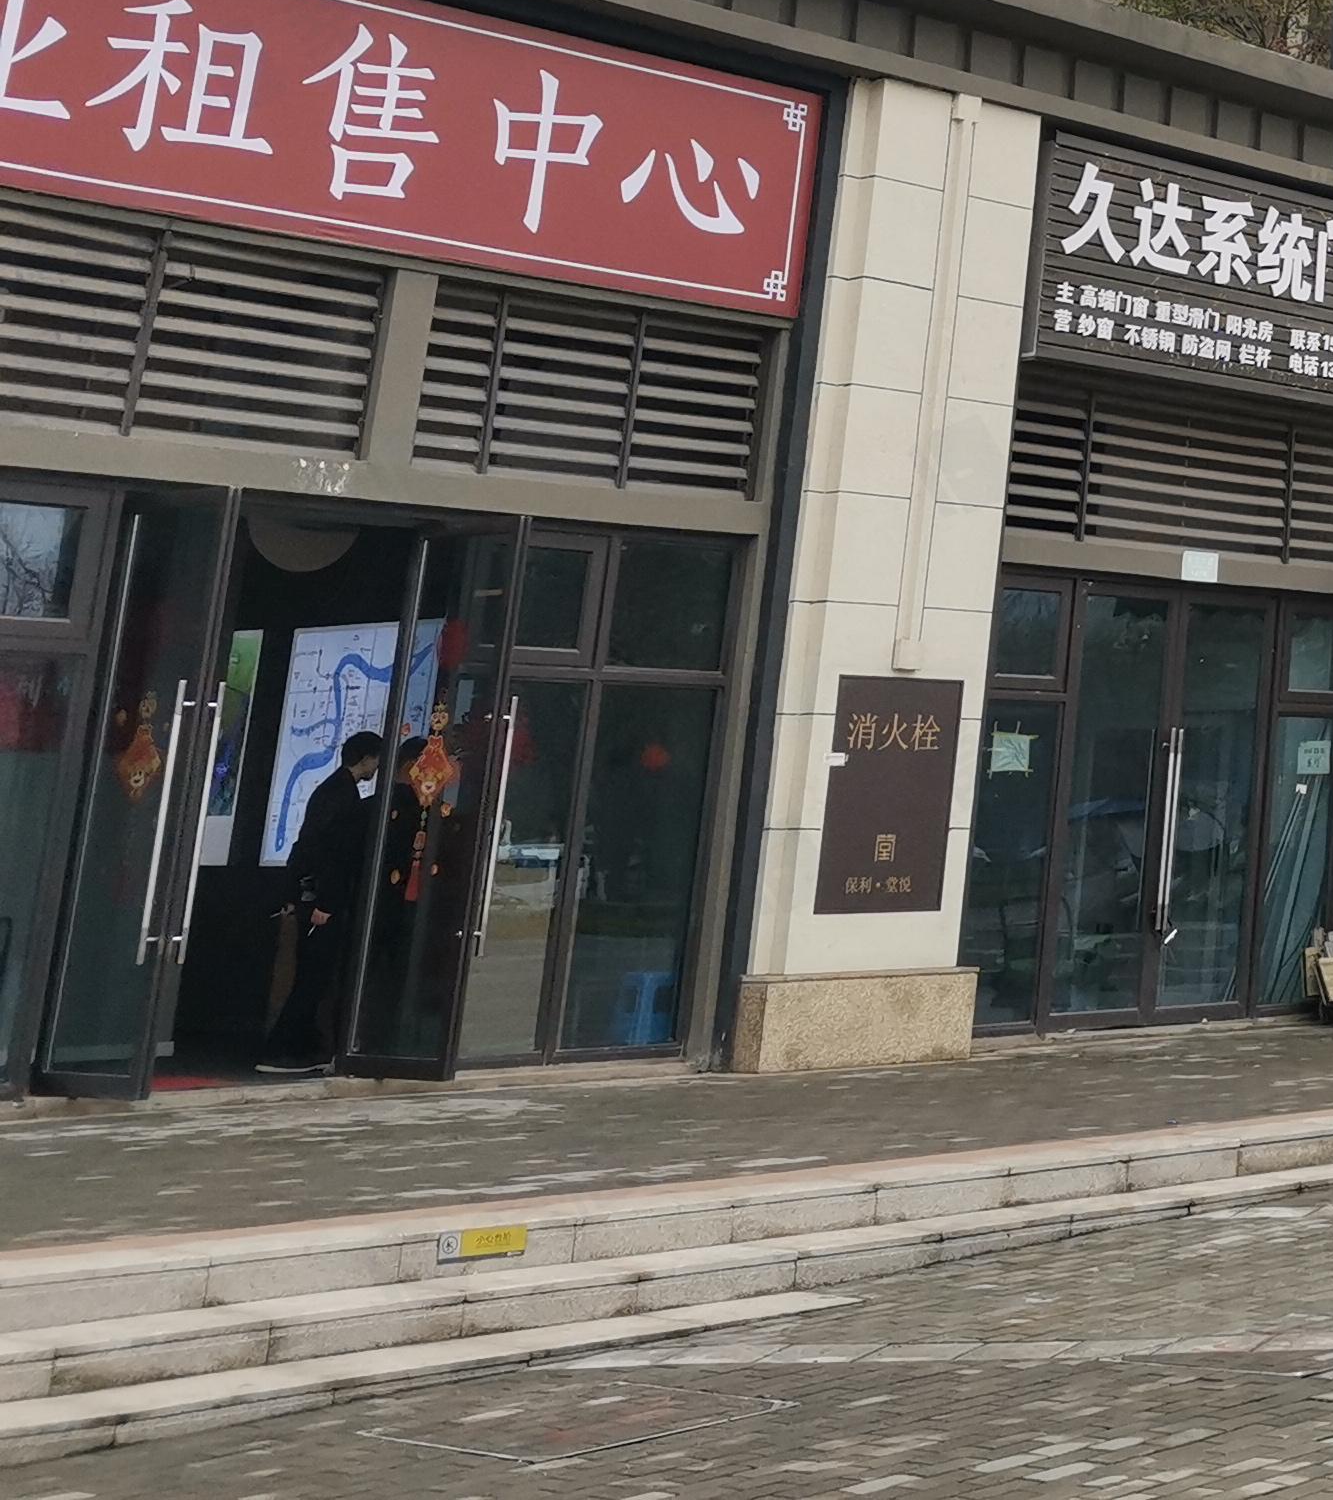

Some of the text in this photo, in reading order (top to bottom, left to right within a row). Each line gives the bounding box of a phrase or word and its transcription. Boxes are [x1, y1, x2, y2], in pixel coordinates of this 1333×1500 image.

[1077, 312, 1115, 341] 纱窗
[1123, 323, 1177, 354] 不锈钢
[1080, 284, 1150, 320] 高端门窗
[1226, 313, 1274, 343] 阳光房
[847, 712, 941, 751] 消火栓
